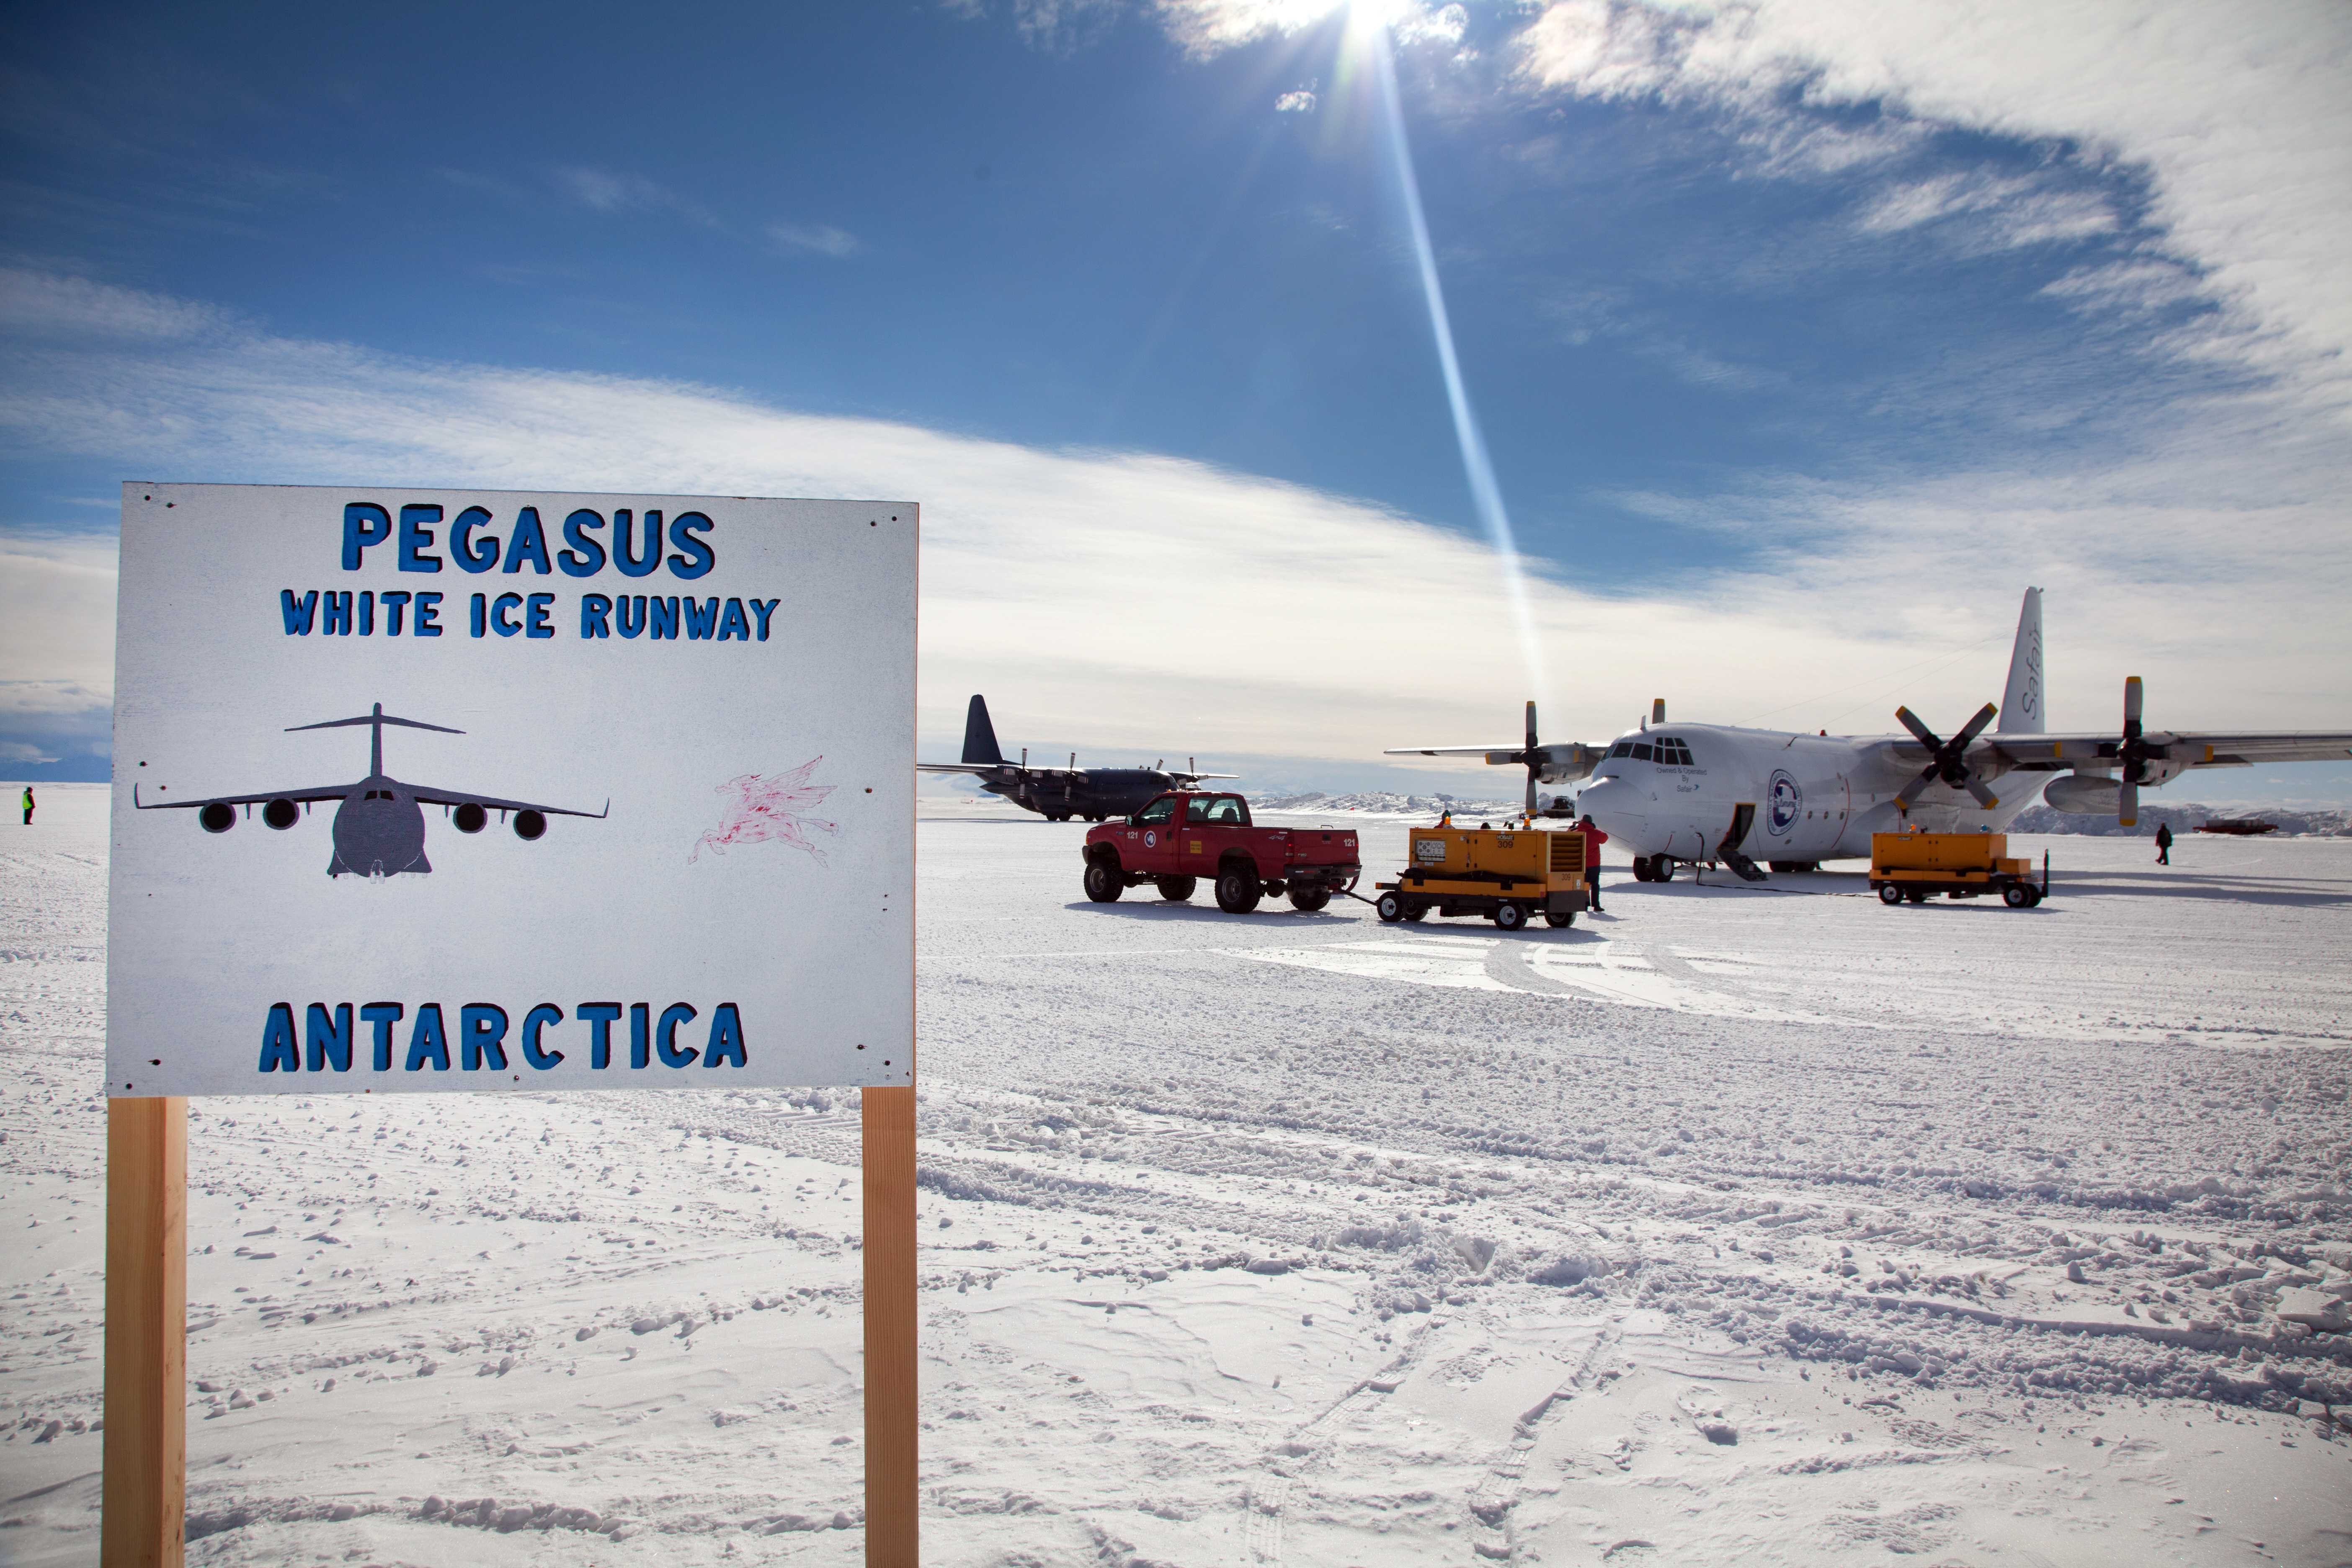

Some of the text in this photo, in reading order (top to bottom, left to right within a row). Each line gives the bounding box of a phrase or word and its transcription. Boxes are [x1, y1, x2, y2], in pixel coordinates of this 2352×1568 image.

[341, 502, 715, 579] PEGASUS
[280, 589, 780, 641] WHITE ICE RUNWAY
[2022, 622, 2041, 720] Safair
[1682, 775, 1689, 783] By
[259, 1002, 747, 1072] ANTARCTICA
